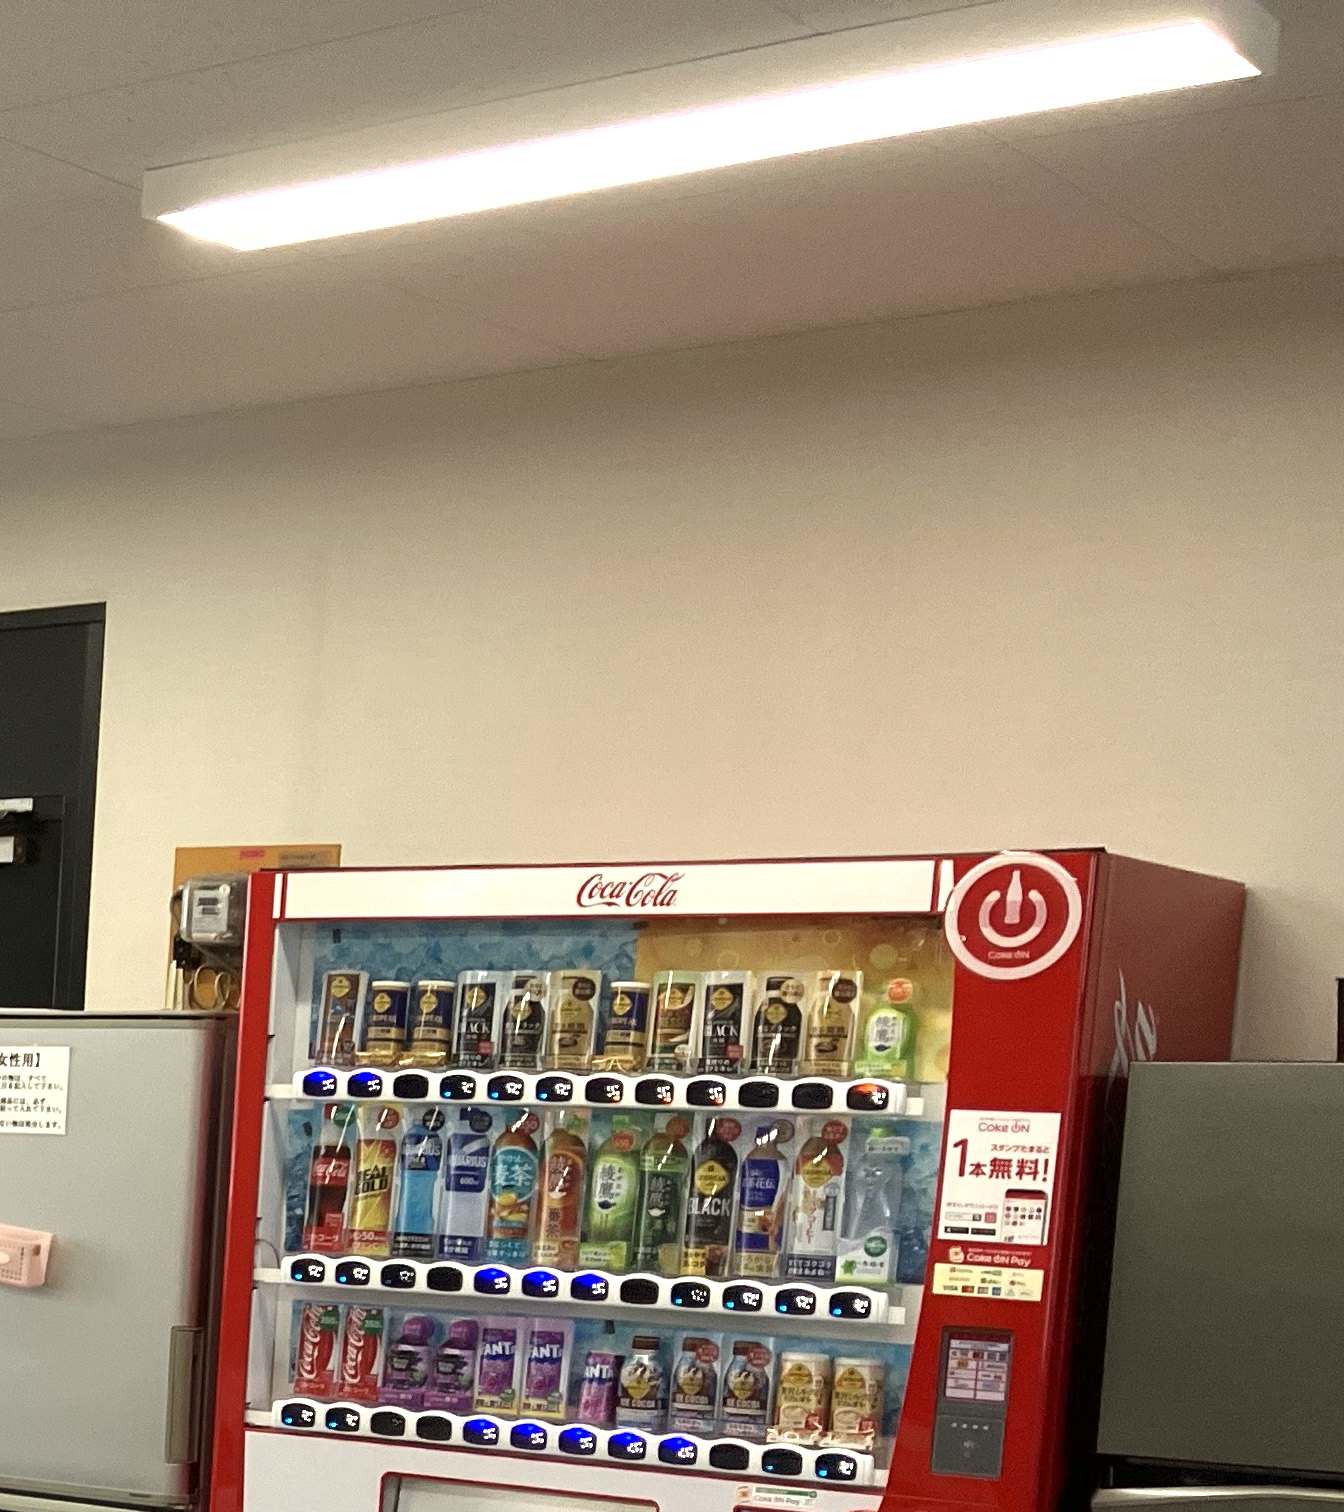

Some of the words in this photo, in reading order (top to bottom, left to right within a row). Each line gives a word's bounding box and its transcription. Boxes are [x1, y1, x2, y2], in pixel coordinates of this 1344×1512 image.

[576, 872, 685, 908] Coca-Cola
[991, 1143, 1050, 1154] スタンプたまると
[481, 1341, 514, 1356] ANT
[529, 1344, 562, 1358] ANT
